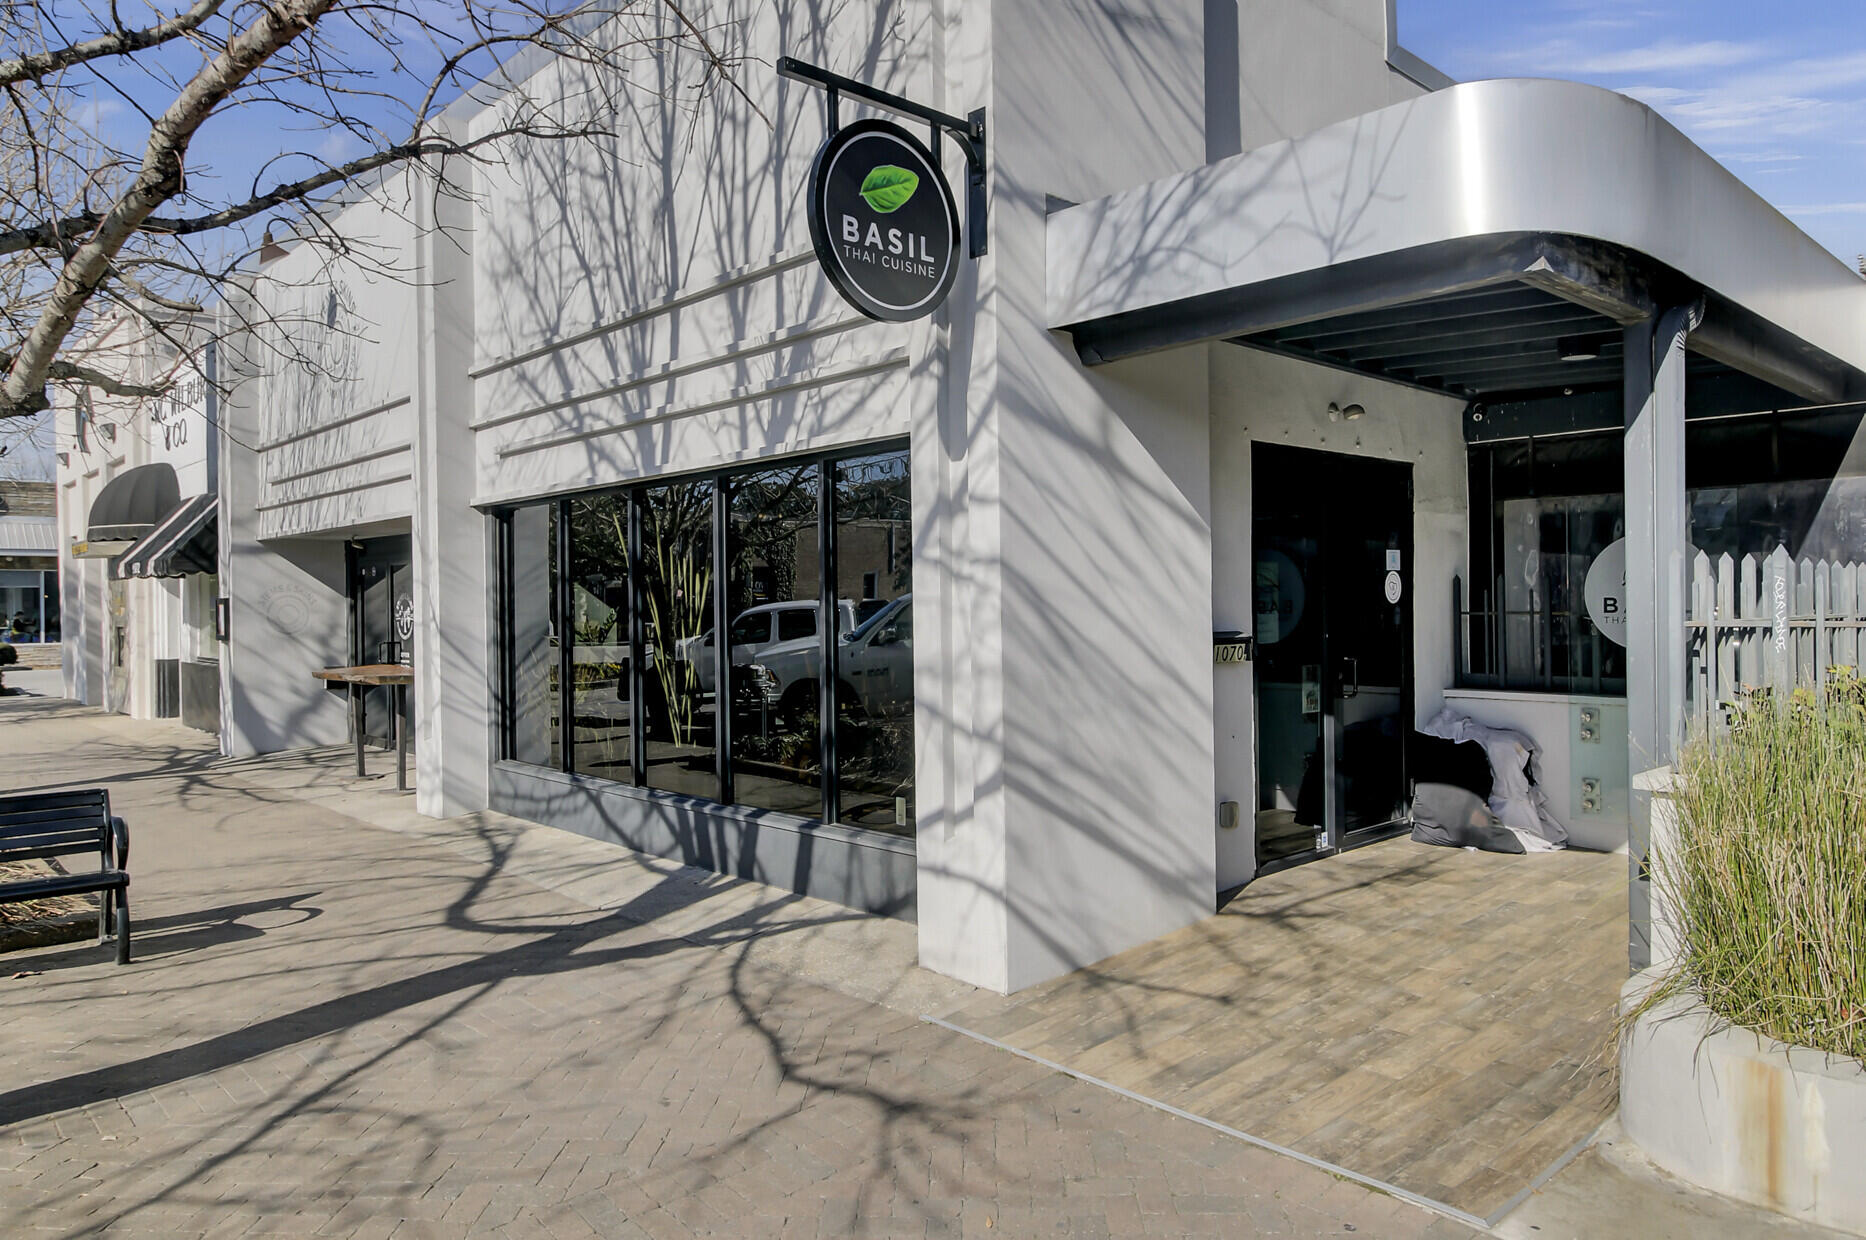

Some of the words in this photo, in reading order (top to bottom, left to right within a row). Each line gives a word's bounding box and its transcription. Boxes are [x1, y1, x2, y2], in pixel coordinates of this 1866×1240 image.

[842, 213, 935, 263] BASIL
[843, 245, 876, 265] THAI
[881, 255, 936, 279] CUISINE
[1603, 616, 1627, 625] THA
[1215, 645, 1244, 662] 1070
